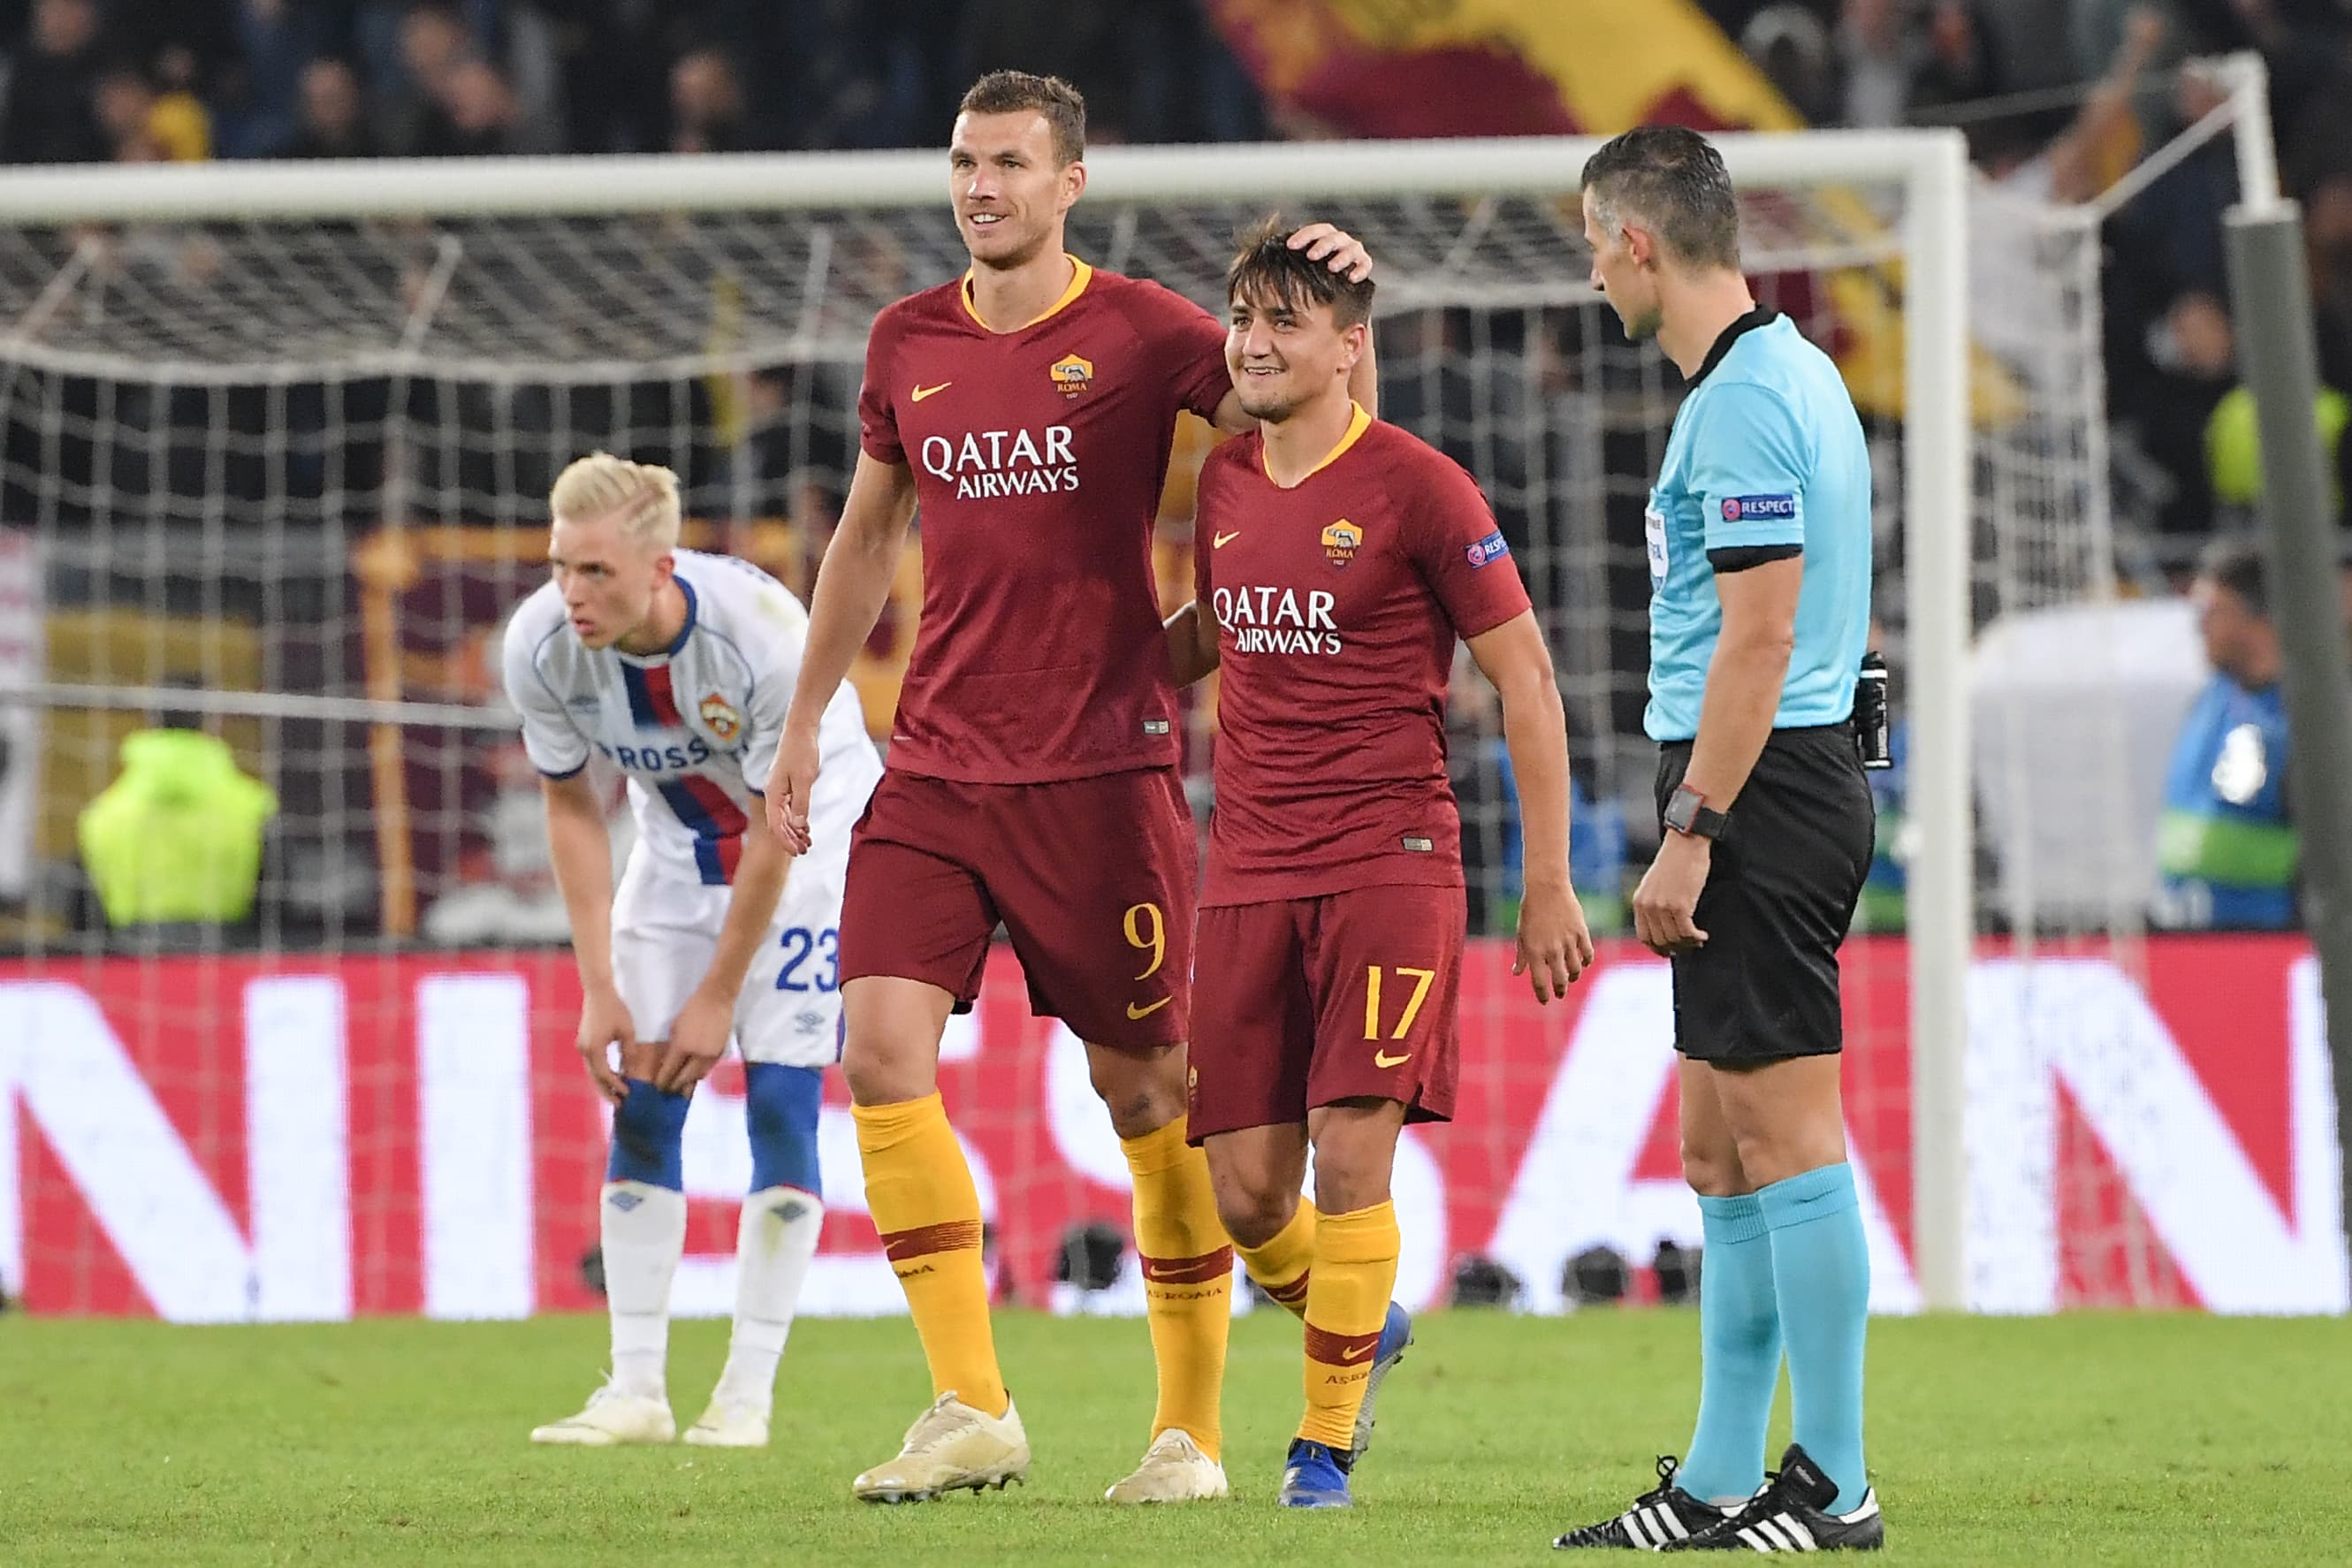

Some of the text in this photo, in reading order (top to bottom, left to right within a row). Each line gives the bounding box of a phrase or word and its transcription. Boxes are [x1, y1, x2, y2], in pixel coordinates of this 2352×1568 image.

[1057, 381, 1087, 392] ROMA
[922, 426, 1077, 483] QATAR
[956, 465, 1080, 499] AIRWAYS
[1741, 499, 1793, 514] RESPECT
[1326, 547, 1353, 559] ROMA
[1213, 585, 1338, 633] QATAR
[1235, 627, 1343, 655] AIRWAYS
[776, 927, 839, 992] 23
[1123, 902, 1166, 981] 9
[1363, 965, 1436, 1040] 17
